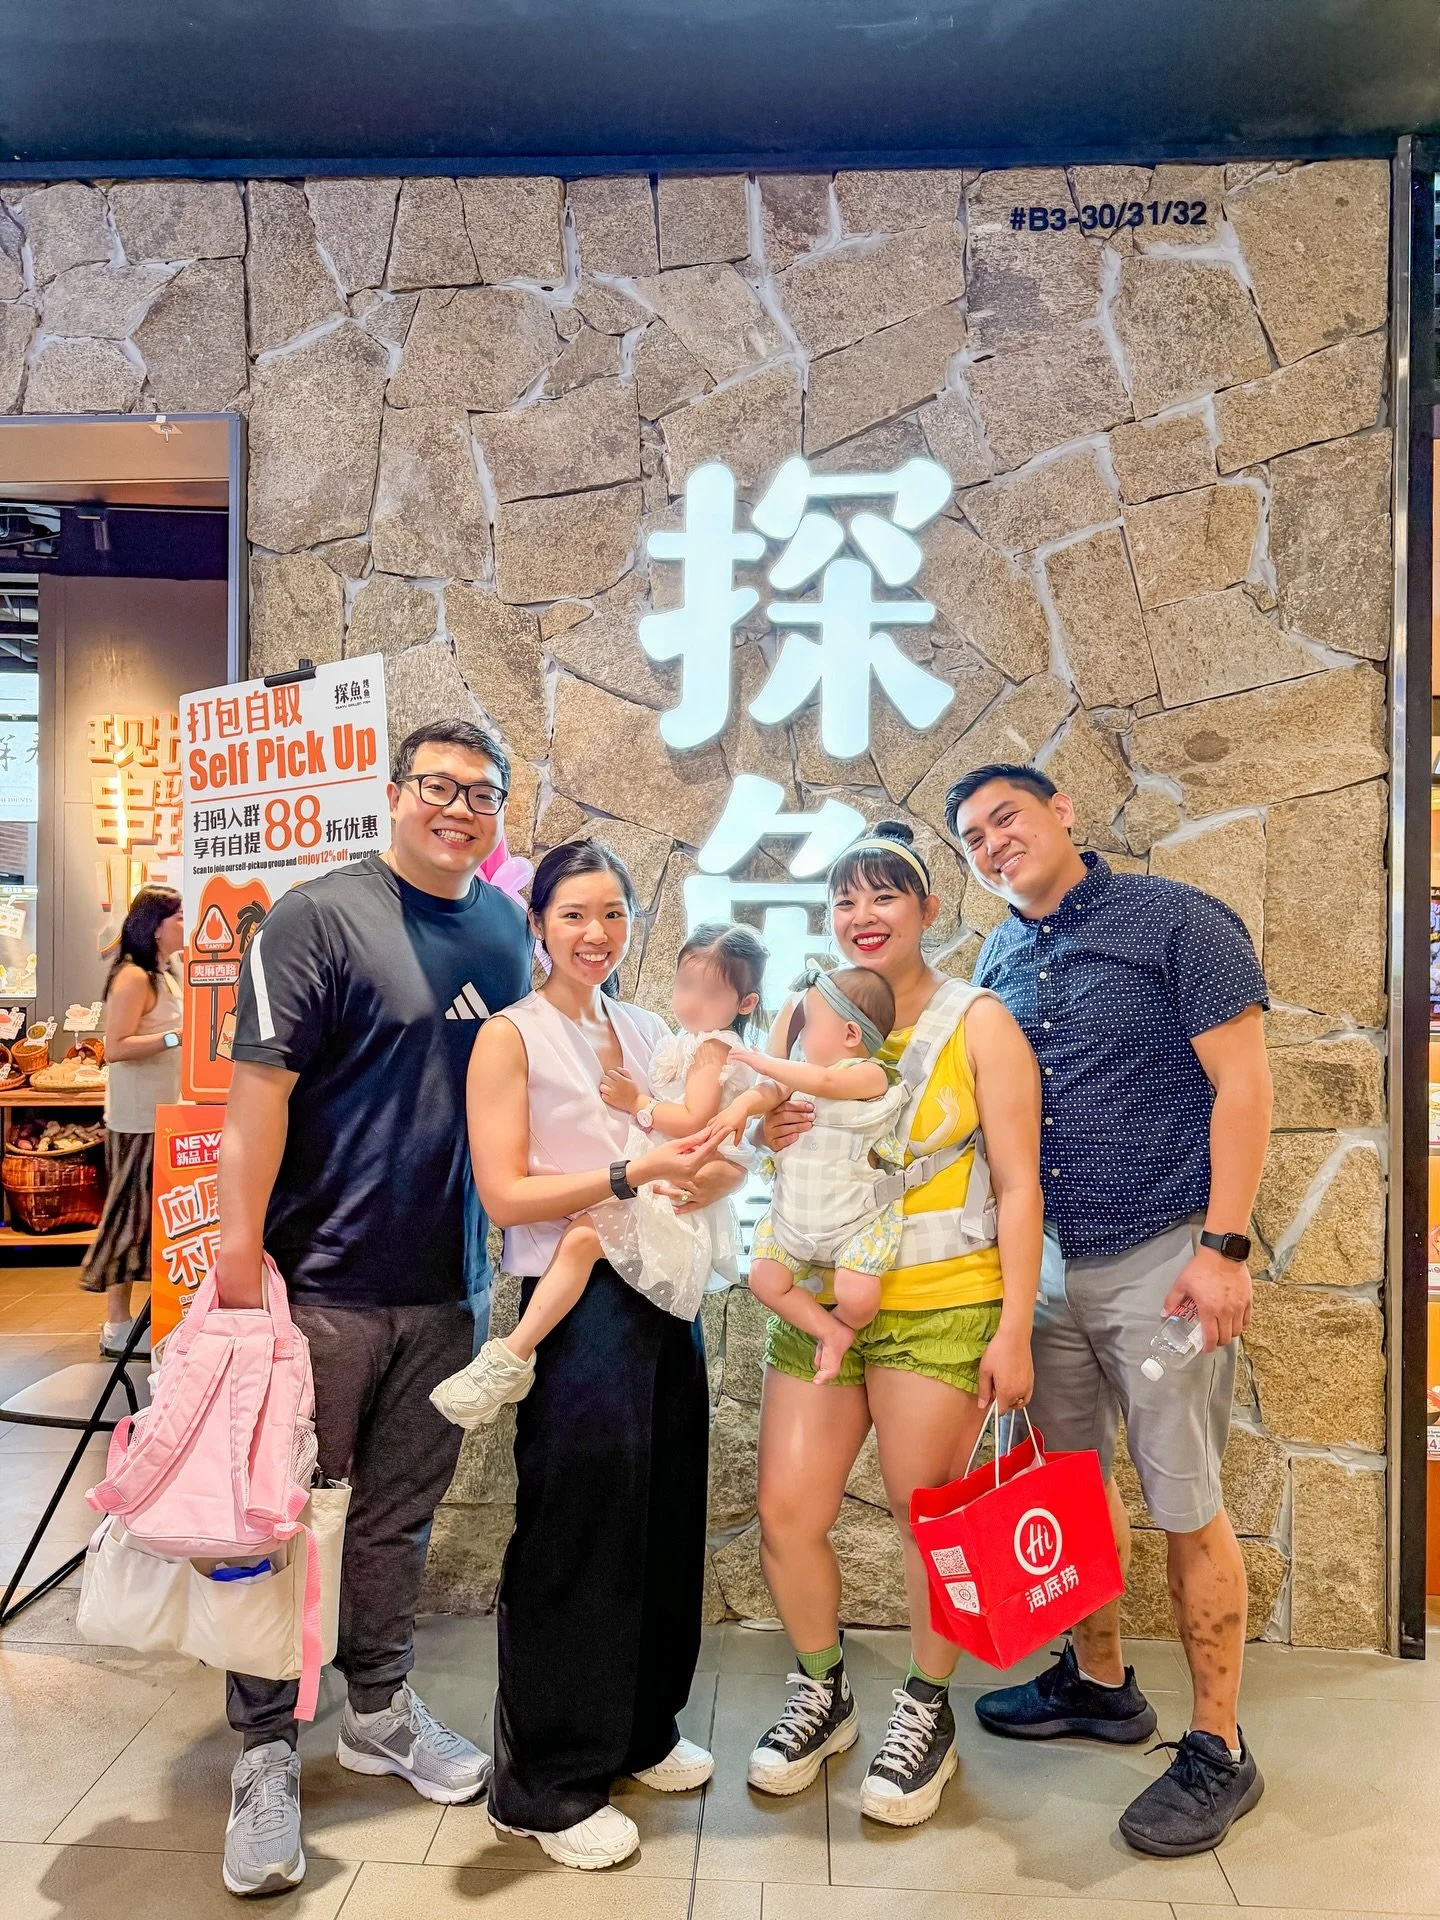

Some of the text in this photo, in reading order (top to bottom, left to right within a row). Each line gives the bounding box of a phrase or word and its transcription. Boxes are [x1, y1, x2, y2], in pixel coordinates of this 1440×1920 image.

[1010, 201, 1207, 231] #B3-30/31/32
[187, 684, 303, 743] 打包自取
[189, 723, 377, 791] Self Pick Up
[193, 803, 261, 833] 扫码入群
[264, 795, 379, 852] 88 折优惠
[192, 866, 207, 875] Scan
[208, 865, 214, 873] to
[214, 864, 225, 874] join
[225, 864, 235, 872] our
[235, 861, 268, 871] self-pickup
[268, 859, 286, 869] group
[286, 857, 297, 866] and
[298, 852, 320, 866] enjoy
[321, 849, 336, 863] 12%
[337, 848, 349, 862] off
[349, 850, 363, 861] your
[193, 832, 261, 859] 享有自提
[175, 1133, 222, 1151] NEW
[1026, 1523, 1053, 1564] Hi
[1024, 1565, 1079, 1613] 海底捞
